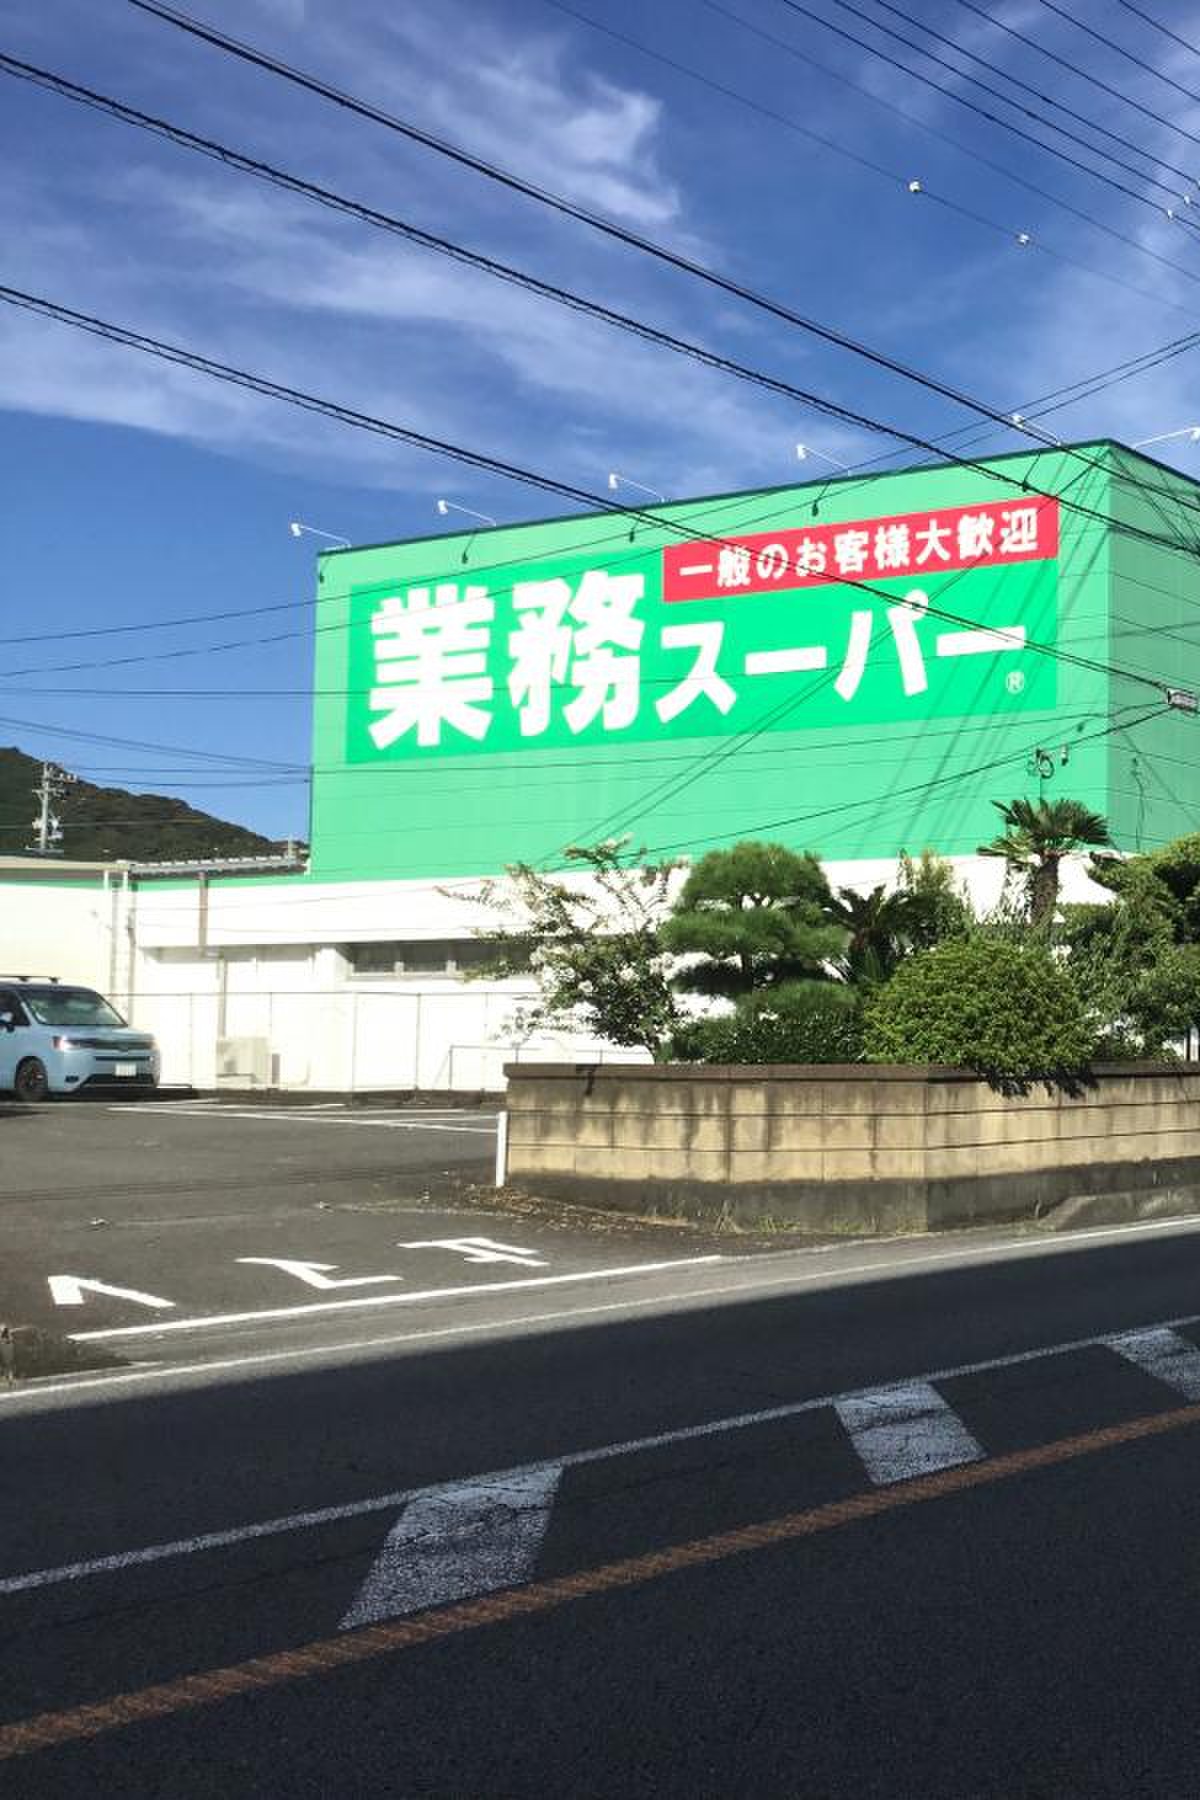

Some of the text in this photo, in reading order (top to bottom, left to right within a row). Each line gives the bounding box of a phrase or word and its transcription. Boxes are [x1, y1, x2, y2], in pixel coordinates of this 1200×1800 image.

[679, 508, 1038, 587] 一般のお客様大歓迎
[367, 570, 1026, 750] 業務スーパー
